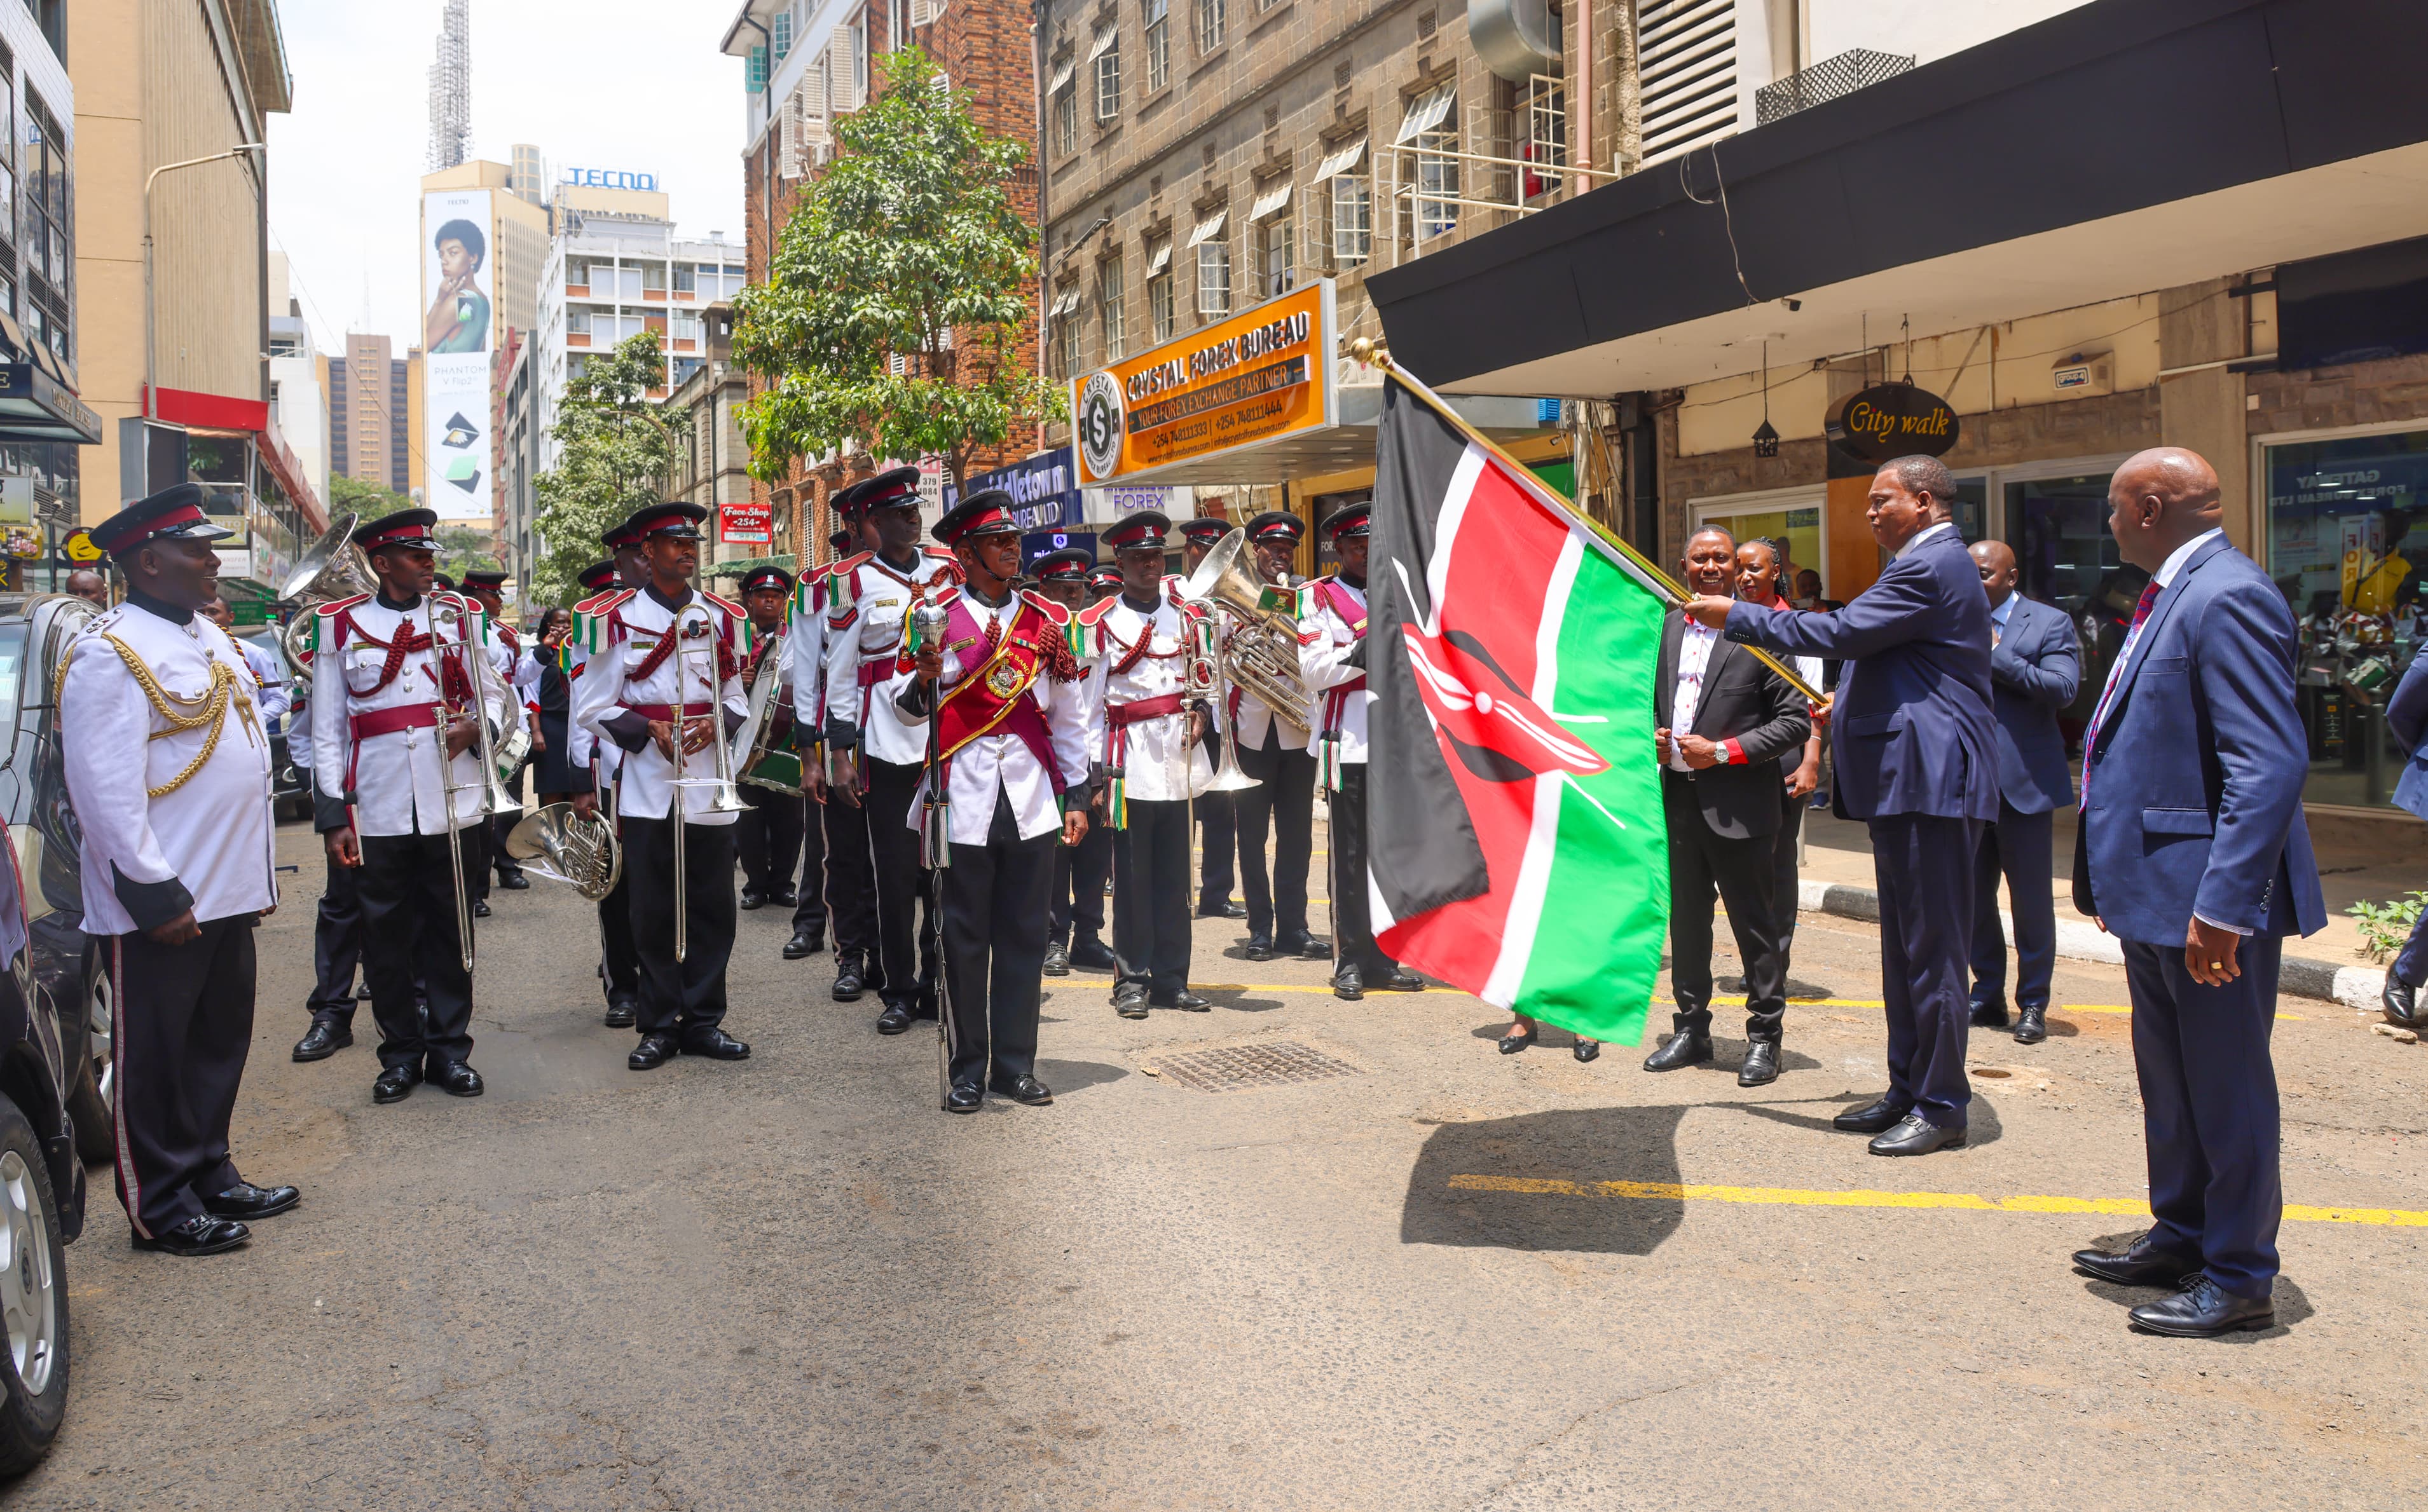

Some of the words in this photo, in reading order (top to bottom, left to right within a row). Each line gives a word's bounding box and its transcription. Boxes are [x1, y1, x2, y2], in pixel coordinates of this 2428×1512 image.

[567, 168, 654, 190] TECNO
[1126, 358, 1188, 402] CRYSTAL
[1189, 337, 1238, 379] FOREX
[1240, 311, 1310, 362] BUREAU
[434, 366, 486, 375] PHANTOM
[1083, 375, 1113, 404] CRYSTAL
[1137, 409, 1158, 428] YOUR
[1160, 401, 1187, 421] FOREX
[1189, 381, 1237, 412] EXCHANGE
[1240, 365, 1287, 397] PARTNER
[1153, 433, 1169, 448] +254
[1170, 421, 1207, 443] 748111333
[1216, 415, 1235, 431] +254
[1237, 399, 1282, 424] 748111444
[1850, 402, 1896, 442] City
[1901, 407, 1951, 436] walk
[1096, 461, 1111, 474] BUREAU
[978, 465, 1067, 505] iddletown
[723, 507, 746, 516] Face
[747, 507, 769, 519] Shop
[1114, 493, 1165, 508] FOREX
[1012, 503, 1045, 529] BUREAU
[1043, 501, 1059, 525] LTD
[1321, 541, 1333, 552] FOR
[1015, 655, 1030, 674] BAND
